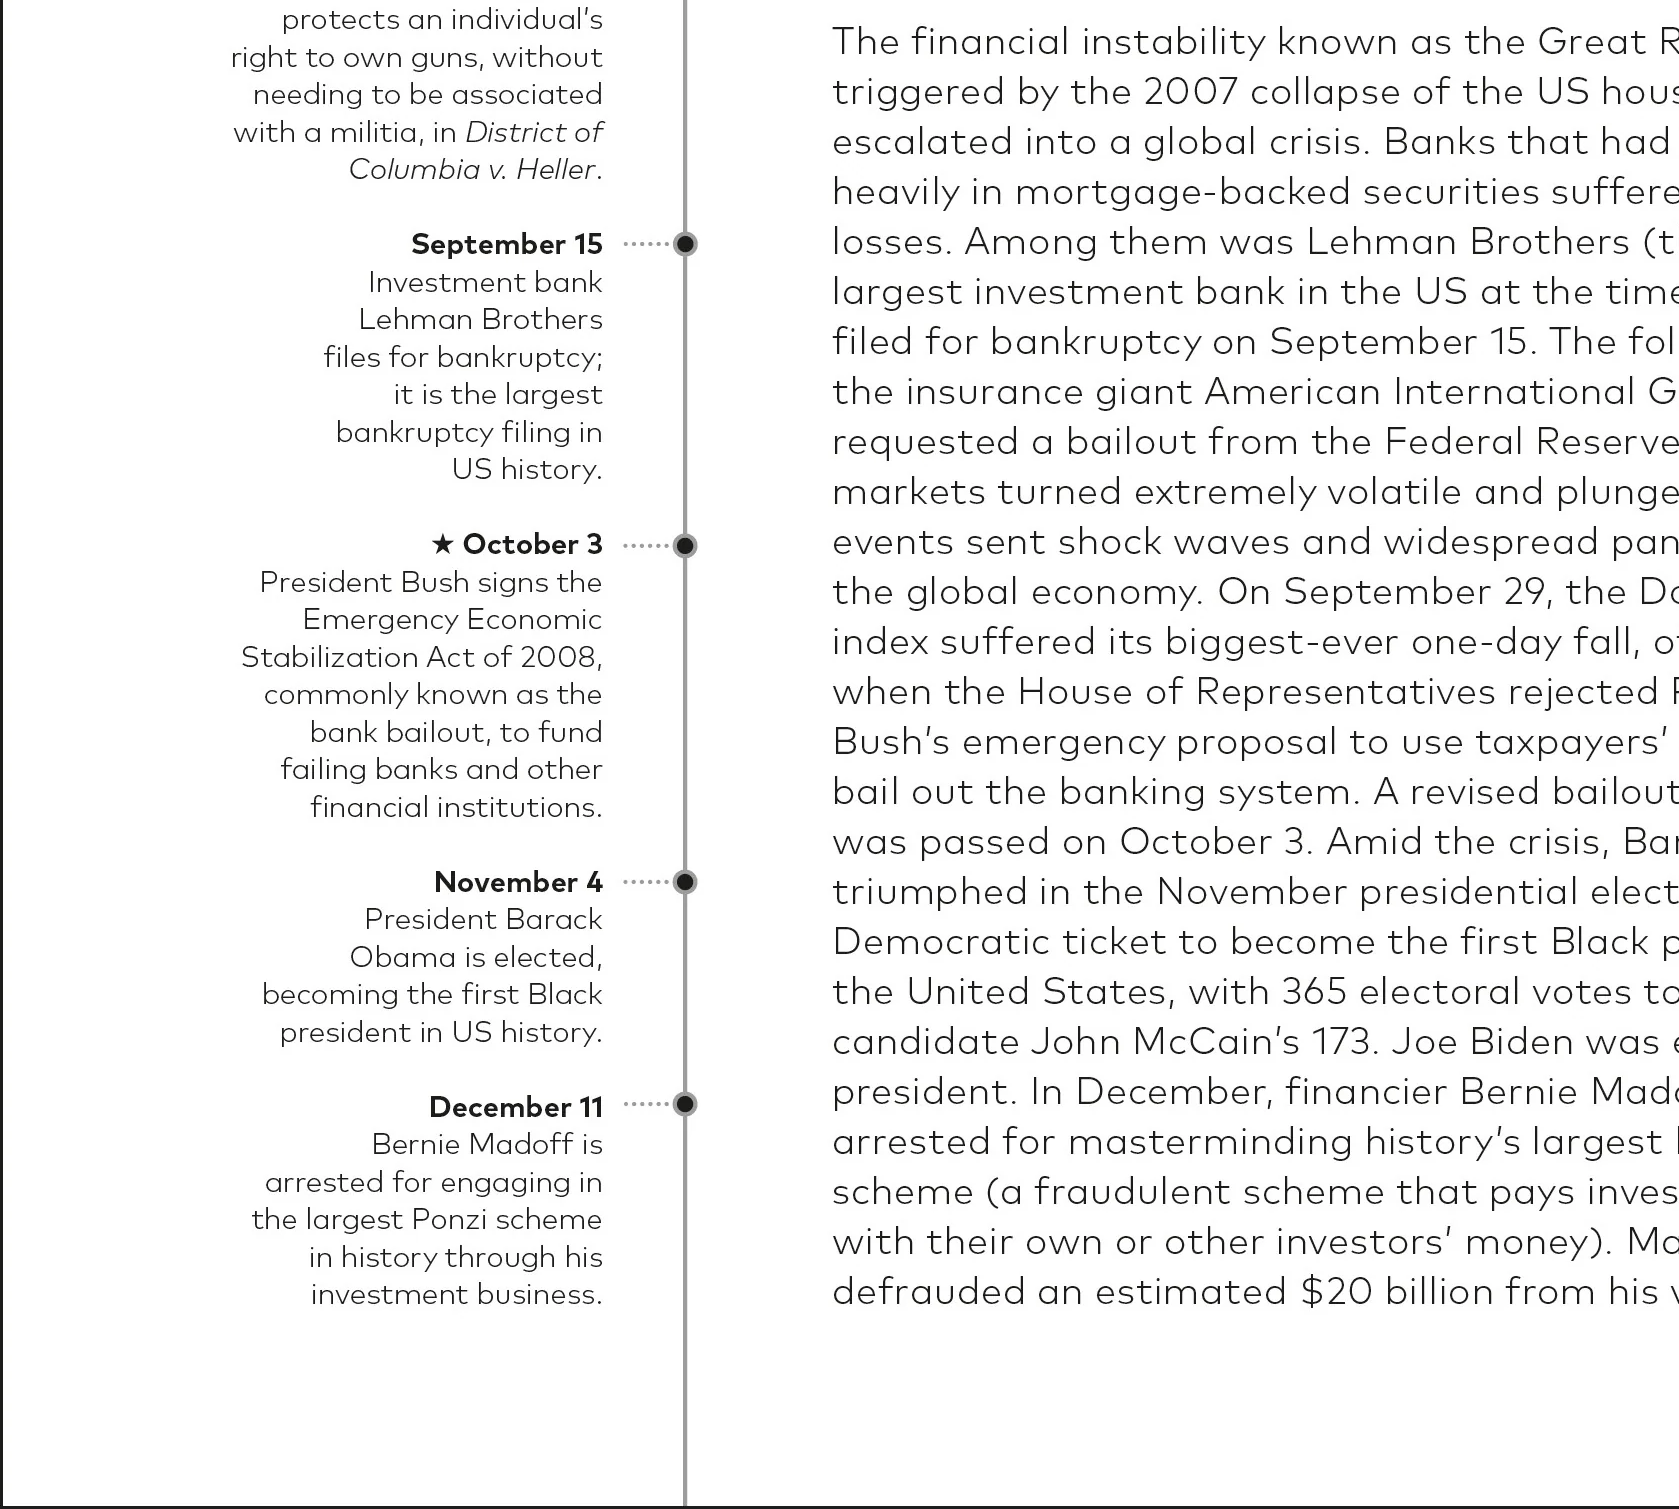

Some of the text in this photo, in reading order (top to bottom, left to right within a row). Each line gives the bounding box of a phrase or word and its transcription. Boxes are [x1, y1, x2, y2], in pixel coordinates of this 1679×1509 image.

[831, 25, 899, 55] The
[911, 25, 1067, 55] financial
[1084, 25, 1267, 62] instability
[1279, 25, 1396, 55] known
[1411, 35, 1451, 55] as
[1464, 25, 1525, 55] the
[1538, 26, 1647, 55] Great
[411, 231, 603, 260] September 15
[463, 531, 603, 555] October 3
[435, 869, 604, 893] November 4
[430, 1094, 602, 1118] December 11
[833, 1275, 1024, 1305] defrauded
[1038, 1285, 1081, 1305] an
[1096, 1275, 1285, 1305] estimated
[1302, 1273, 1372, 1309] $20
[1387, 1275, 1492, 1305] billion
[1505, 1275, 1594, 1305] from
[1610, 1275, 1658, 1305] his
